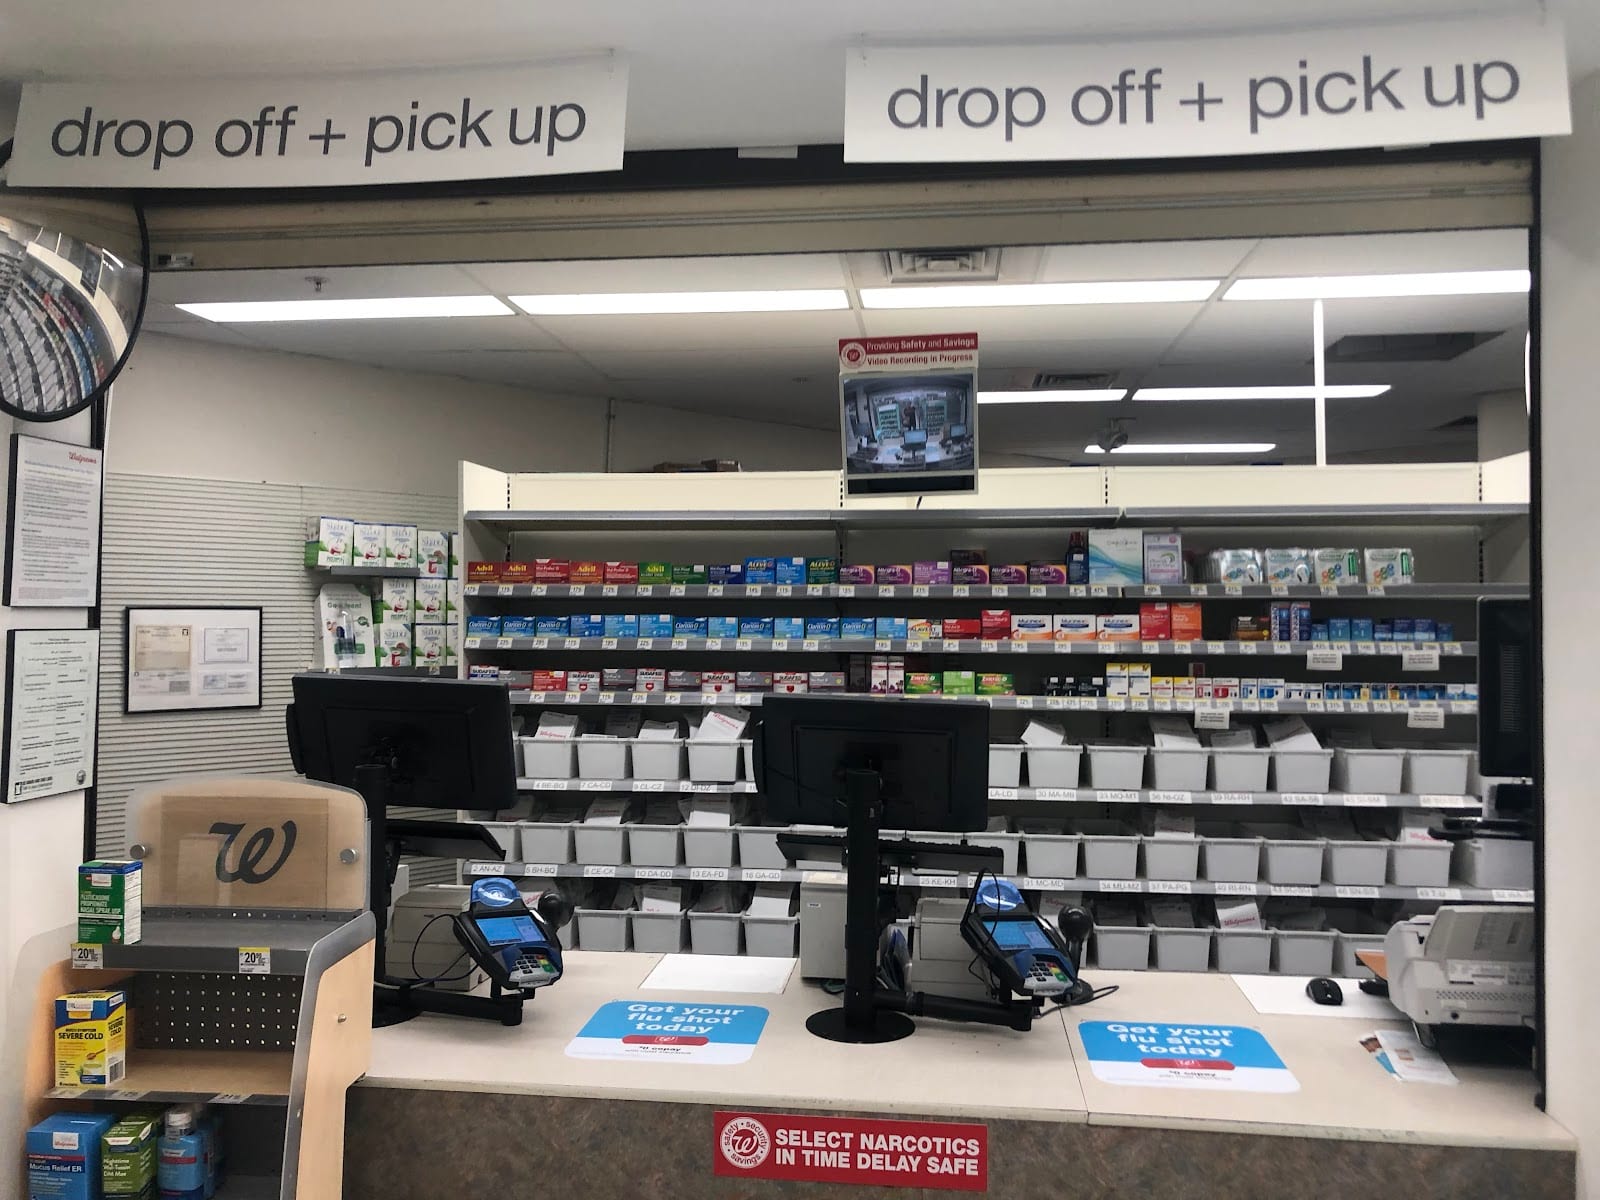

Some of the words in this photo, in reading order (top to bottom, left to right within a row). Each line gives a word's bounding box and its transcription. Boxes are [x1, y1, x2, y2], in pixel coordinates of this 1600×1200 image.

[888, 75, 1045, 141] drop
[1071, 69, 1162, 126] off
[1250, 56, 1405, 133] pick
[1424, 59, 1520, 119] up
[51, 107, 193, 170] drop
[214, 106, 299, 157] off
[365, 98, 494, 166] pick
[509, 102, 586, 156] up
[867, 341, 900, 351] Providing
[901, 339, 926, 350] Safety
[928, 339, 942, 348] and
[943, 338, 975, 348] Savings
[867, 356, 888, 366] Video
[890, 355, 928, 365] Recording
[930, 354, 938, 362] in
[939, 353, 973, 362] Progress
[69, 451, 97, 464] Walgreens
[208, 820, 298, 884] W
[1224, 916, 1256, 927] Walgreens
[628, 1004, 676, 1013] Get
[682, 1007, 744, 1016] your
[627, 1012, 662, 1022] flu
[672, 1014, 732, 1025] shot
[635, 1022, 713, 1034] today
[1106, 1024, 1159, 1034] Get
[1167, 1028, 1233, 1037] your
[84, 1032, 104, 1040] COLD
[1117, 1034, 1156, 1043] flu
[1166, 1036, 1234, 1048] shot
[1136, 1044, 1223, 1058] today
[725, 1122, 739, 1146] safety
[746, 1122, 767, 1149] security
[775, 1128, 853, 1148] SELECT
[860, 1134, 980, 1156] NARCOTICS
[731, 1154, 760, 1165] savings
[775, 1148, 795, 1166] IN
[802, 1150, 850, 1169] TIME
[857, 1153, 921, 1172] DELAY
[926, 1156, 979, 1176] SAFE
[29, 1163, 50, 1171] Mucus
[52, 1164, 70, 1172] Relief
